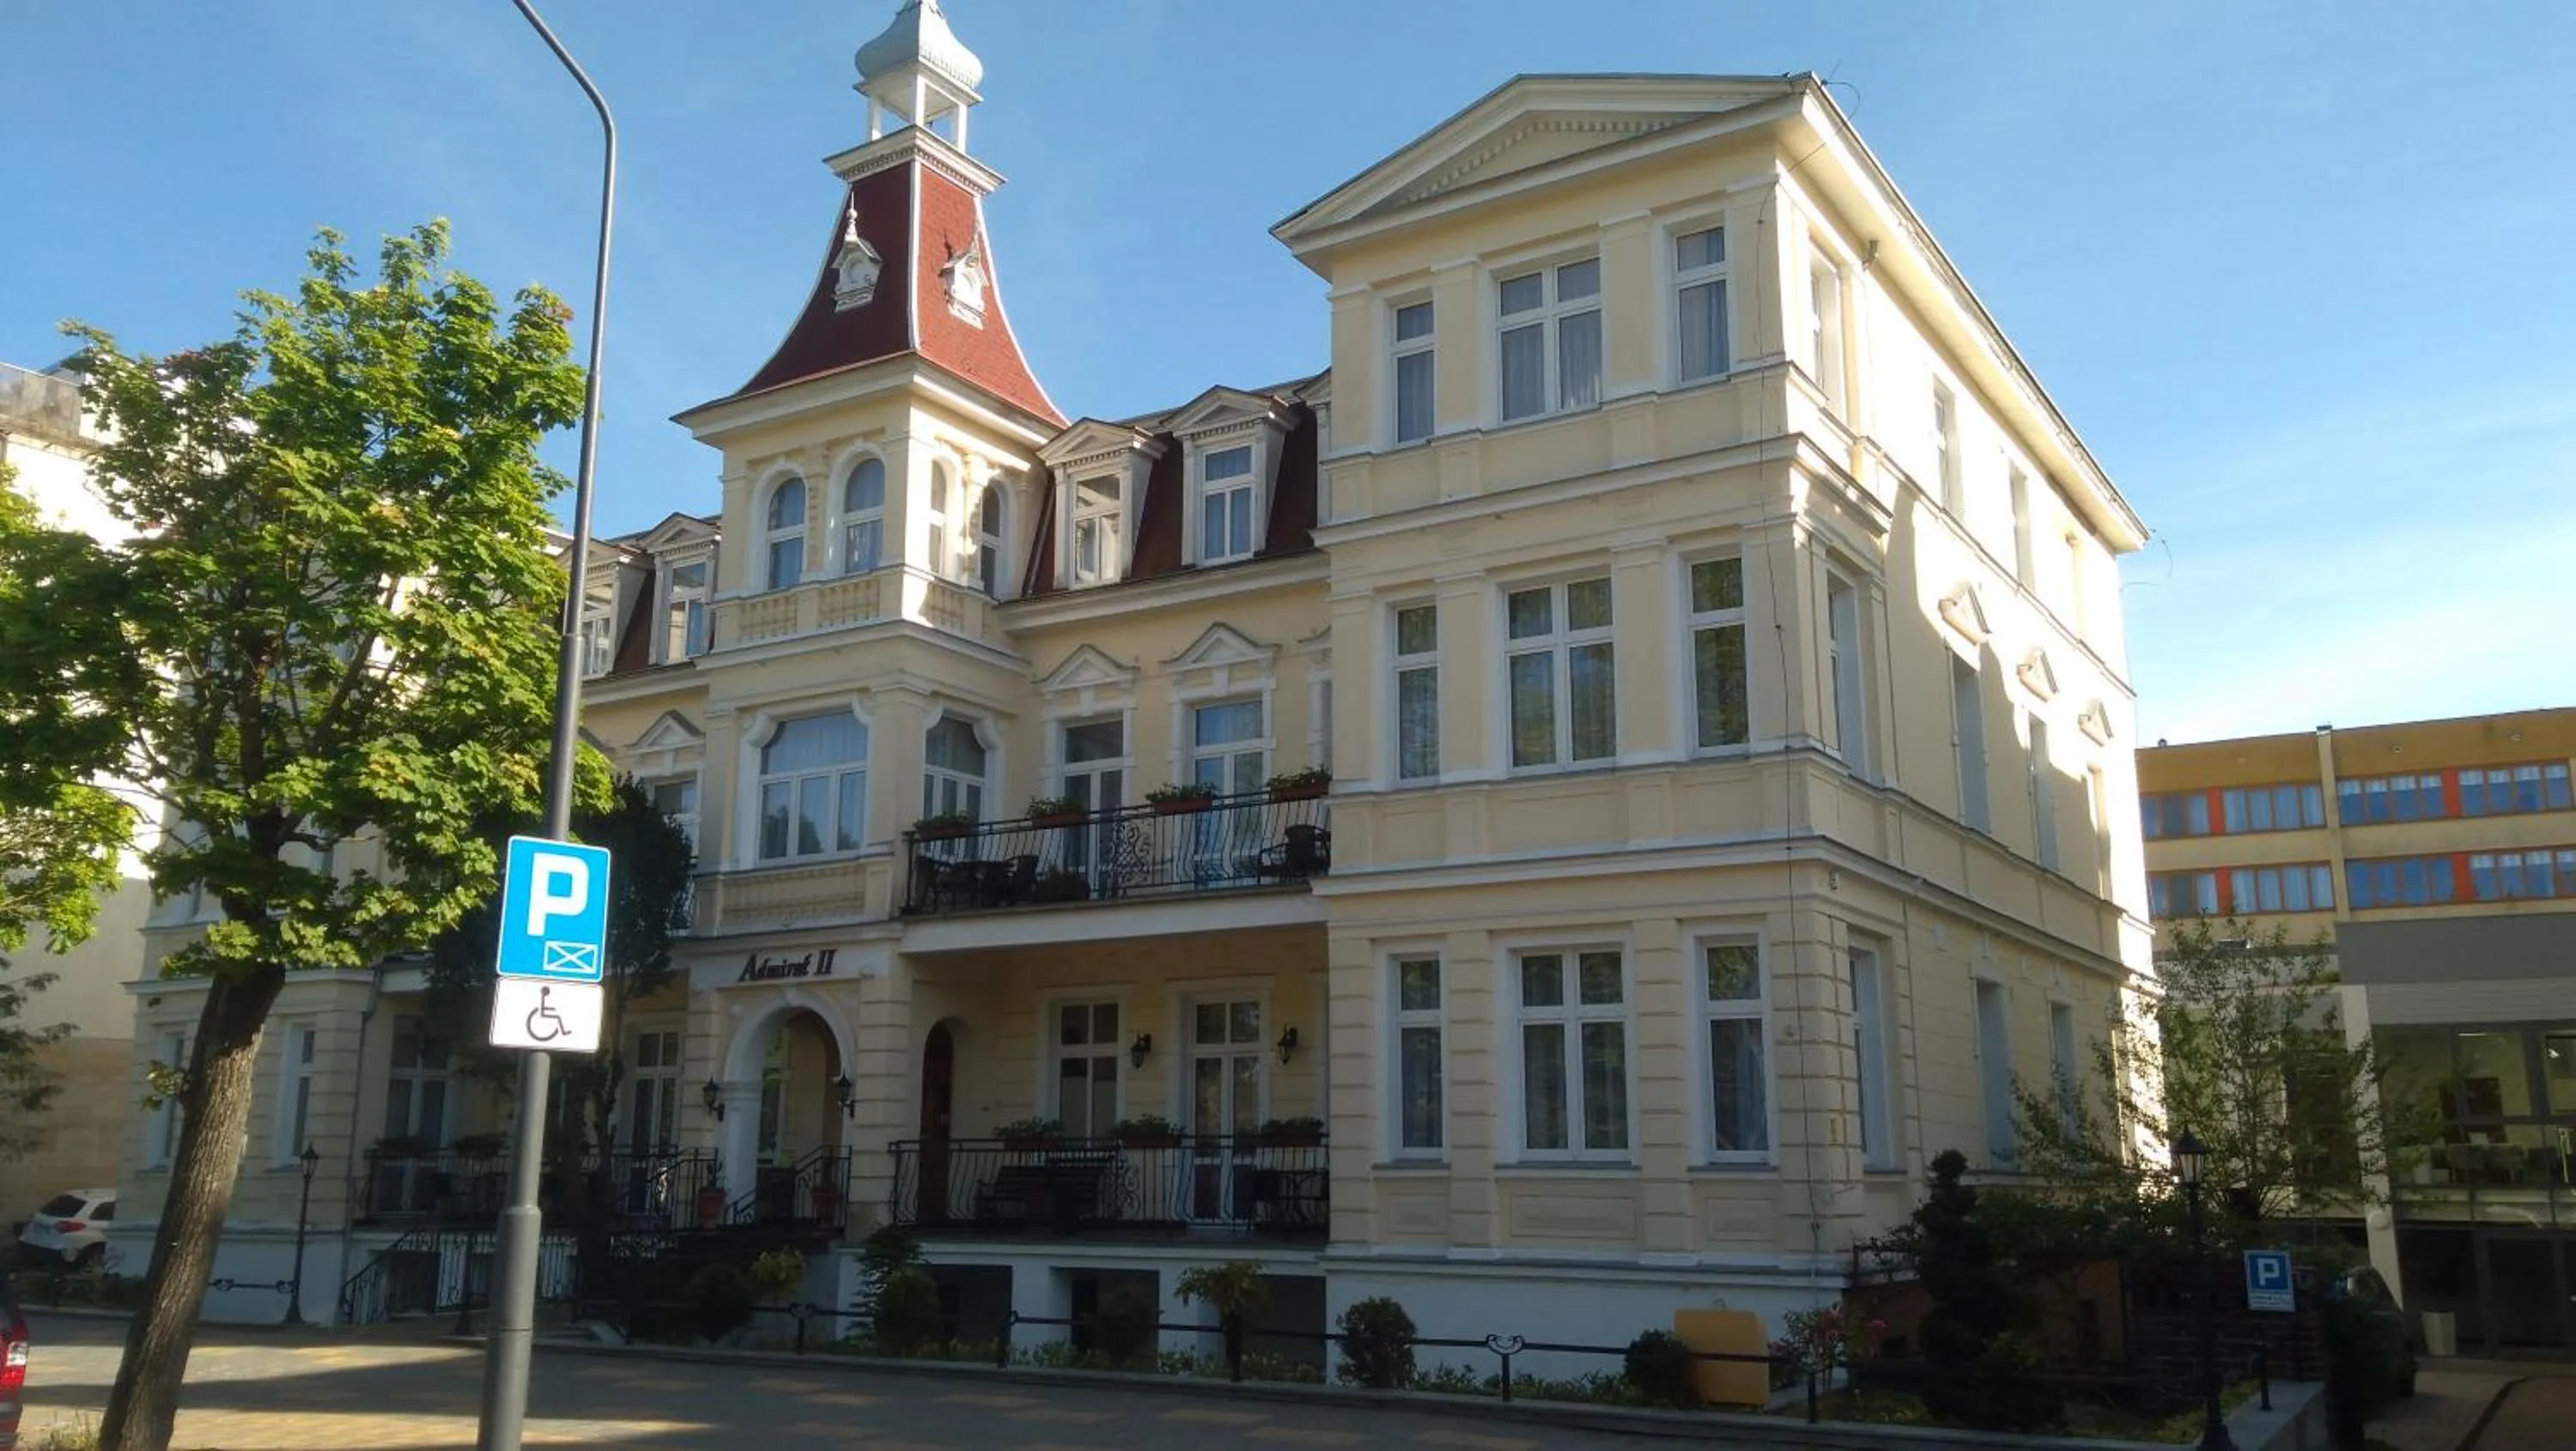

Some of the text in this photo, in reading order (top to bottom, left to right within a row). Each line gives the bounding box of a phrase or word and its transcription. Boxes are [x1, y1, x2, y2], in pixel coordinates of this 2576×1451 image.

[526, 852, 590, 937] P
[814, 948, 838, 975] II
[2257, 1258, 2281, 1286] P
